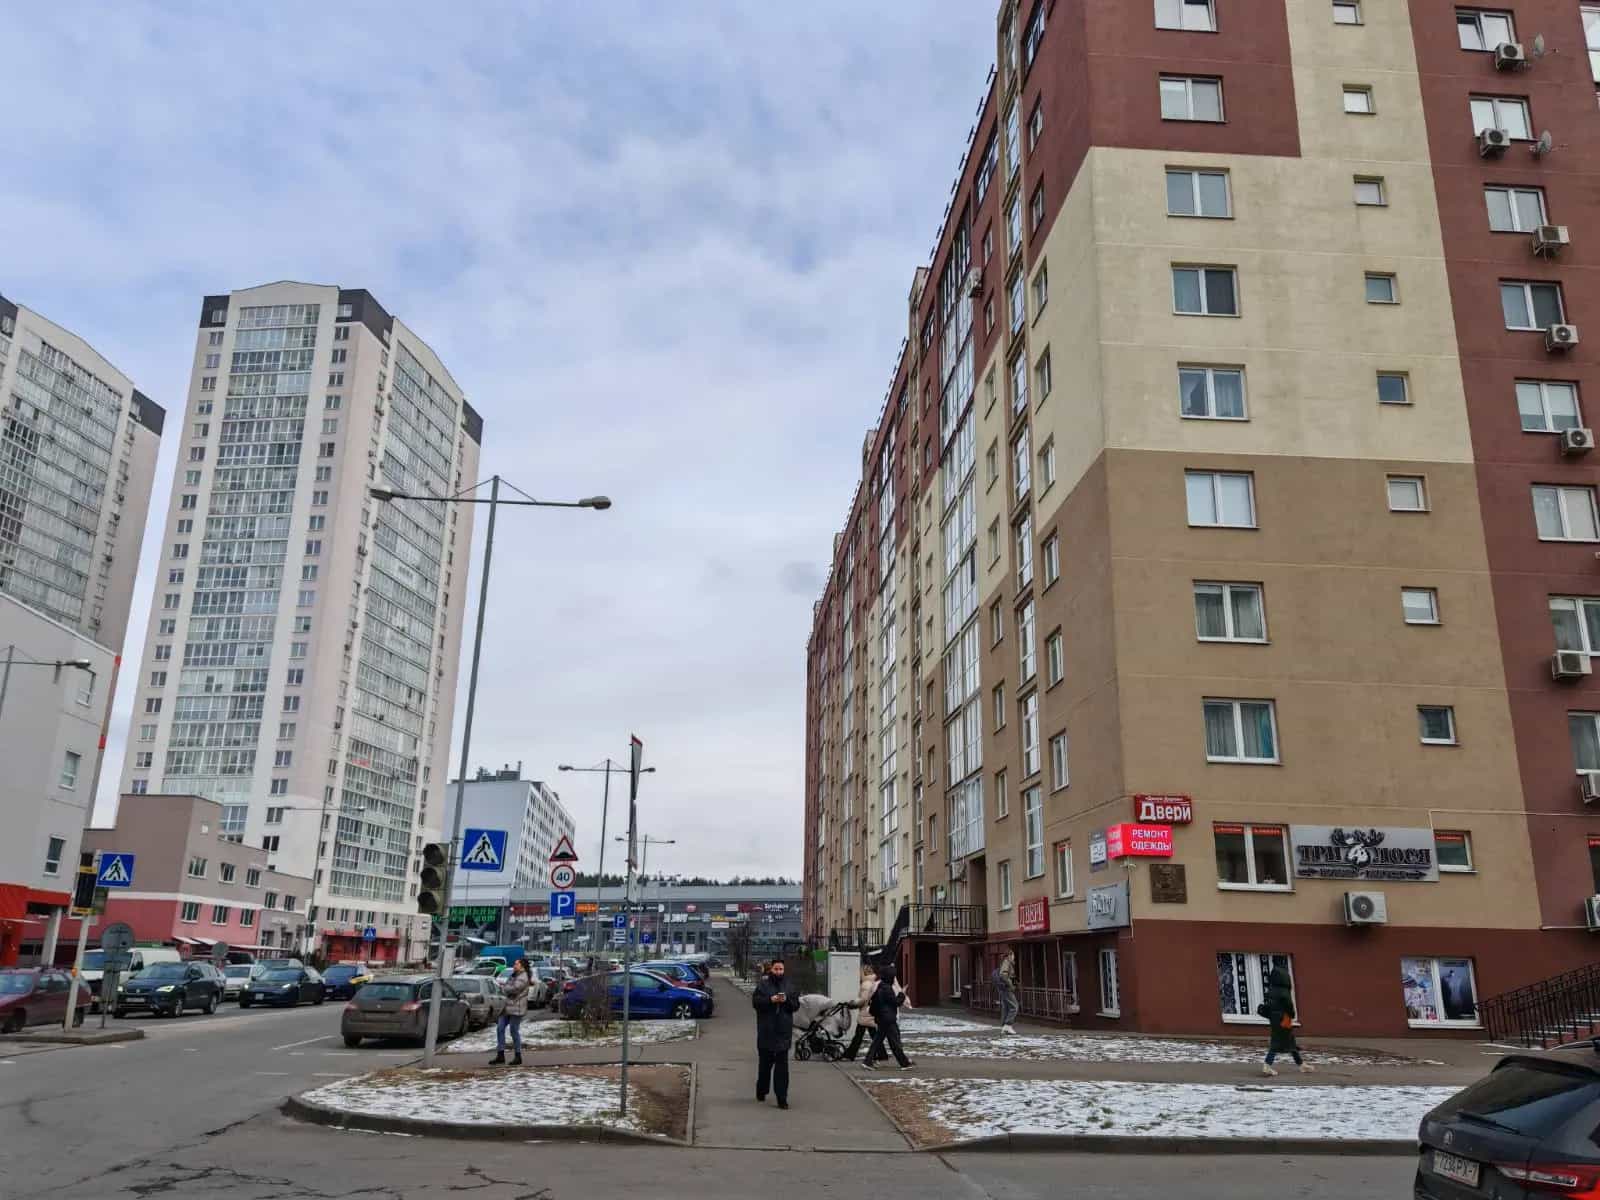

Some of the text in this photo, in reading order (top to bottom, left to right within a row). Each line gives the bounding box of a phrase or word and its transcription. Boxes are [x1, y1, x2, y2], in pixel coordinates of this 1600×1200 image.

[1140, 801, 1192, 821] Двери
[1132, 829, 1169, 838] РЕМОНТ
[1131, 841, 1172, 850] ОДЕЖДЫ
[1298, 845, 1431, 864] ТРИ ЛОСЯ
[556, 872, 570, 881] 40
[557, 894, 571, 915] P
